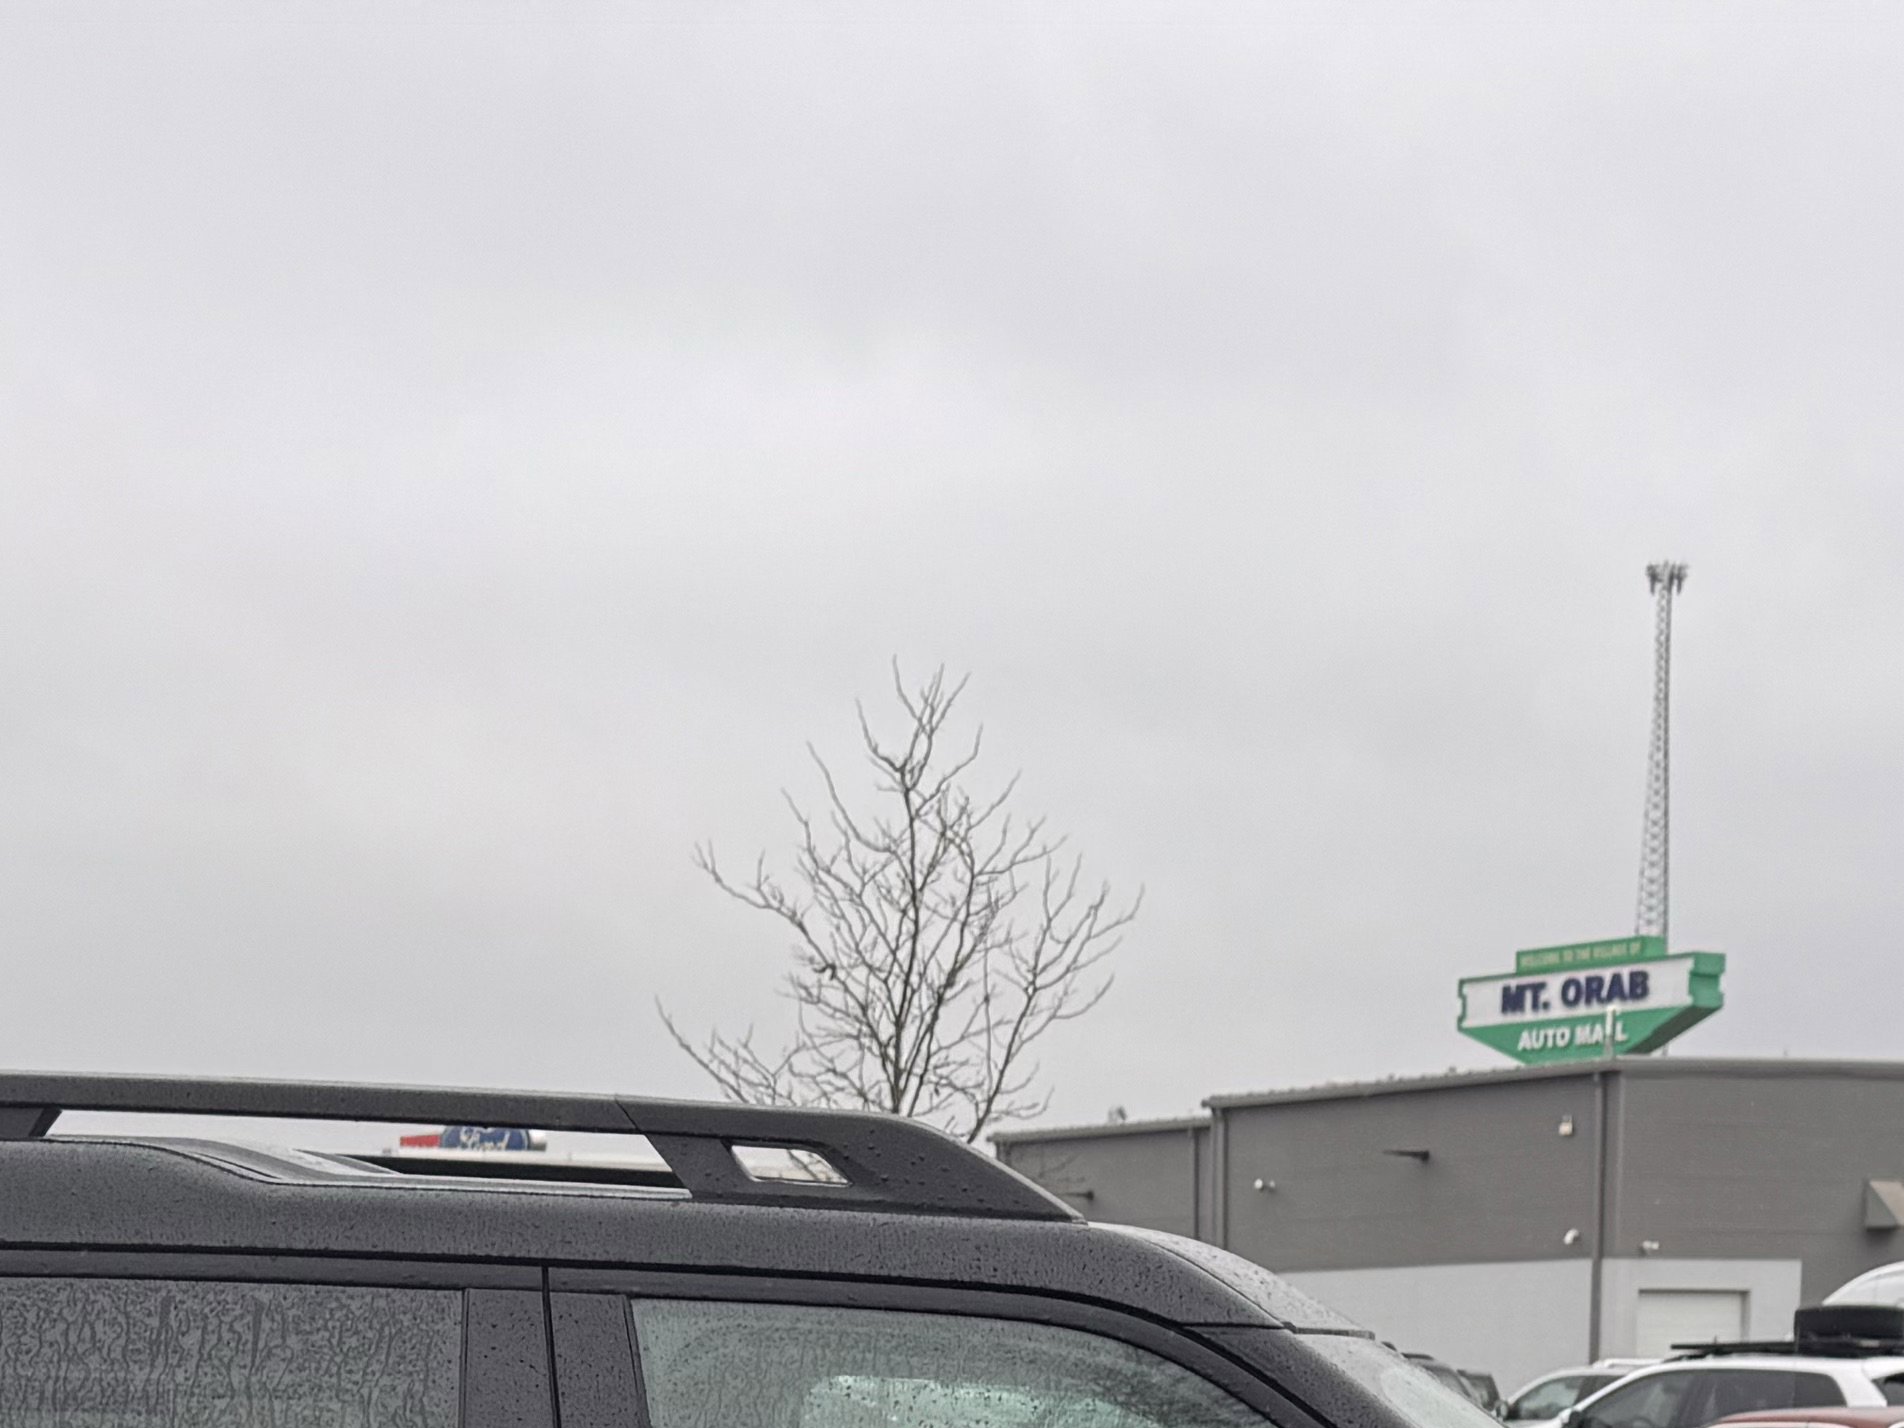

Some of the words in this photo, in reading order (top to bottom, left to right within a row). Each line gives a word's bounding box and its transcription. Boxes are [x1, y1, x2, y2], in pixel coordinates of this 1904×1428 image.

[1501, 982, 1550, 1014] MT.
[1561, 971, 1650, 1008] ORAB
[1517, 1026, 1571, 1051] AUTO
[1574, 1021, 1628, 1045] MAL
